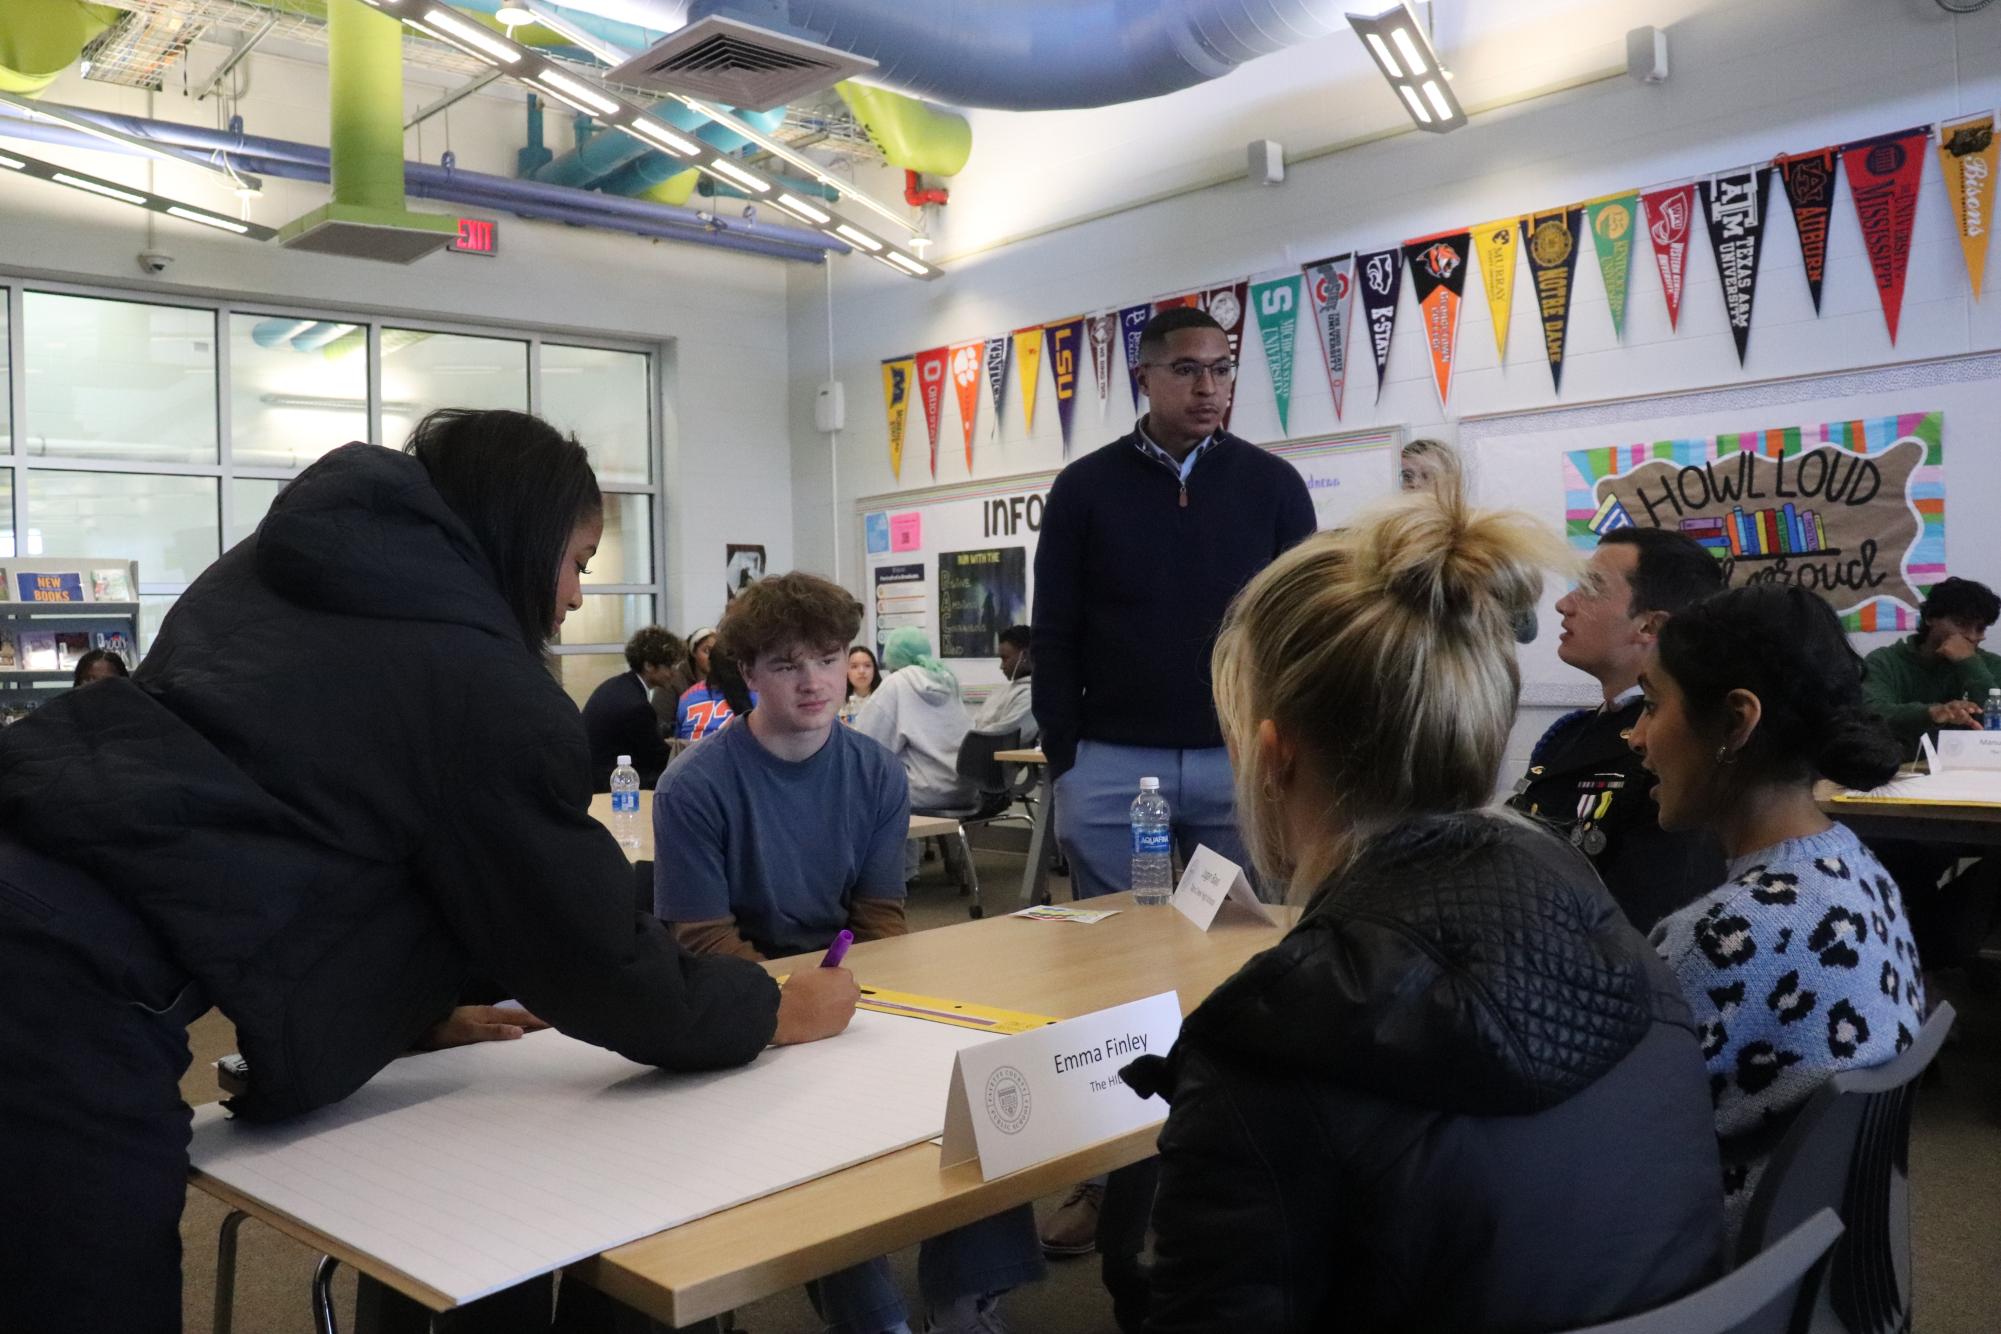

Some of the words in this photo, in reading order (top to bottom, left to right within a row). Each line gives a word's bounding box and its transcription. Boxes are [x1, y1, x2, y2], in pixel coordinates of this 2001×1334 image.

[1964, 155, 1989, 238] Bisons
[456, 217, 494, 252] EXIT
[1795, 206, 1828, 282] AUBURN
[1855, 179, 1896, 289] MISSISSIPPI
[1718, 241, 1741, 327] UNIVERSITY
[1735, 236, 1755, 288] TEXAS
[1537, 267, 1568, 317] NOTRE
[1735, 292, 1751, 328] A&M
[1054, 328, 1073, 400] LSU
[1261, 326, 1284, 395] UNIVERSITY
[1279, 318, 1294, 369] MICHIGAN
[1544, 321, 1564, 362] DAME
[1307, 474, 1341, 489] dness
[1637, 449, 1767, 528] HOWL
[1775, 448, 1882, 506] LOUD
[33, 590, 70, 602] BOOKS
[37, 576, 61, 588] NEW
[1140, 835, 1169, 845] AQUAFIN
[1053, 1047, 1103, 1074] Emma
[1104, 1032, 1149, 1058] Finley
[1089, 1078, 1107, 1094] The
[1107, 1073, 1124, 1088] HIL
